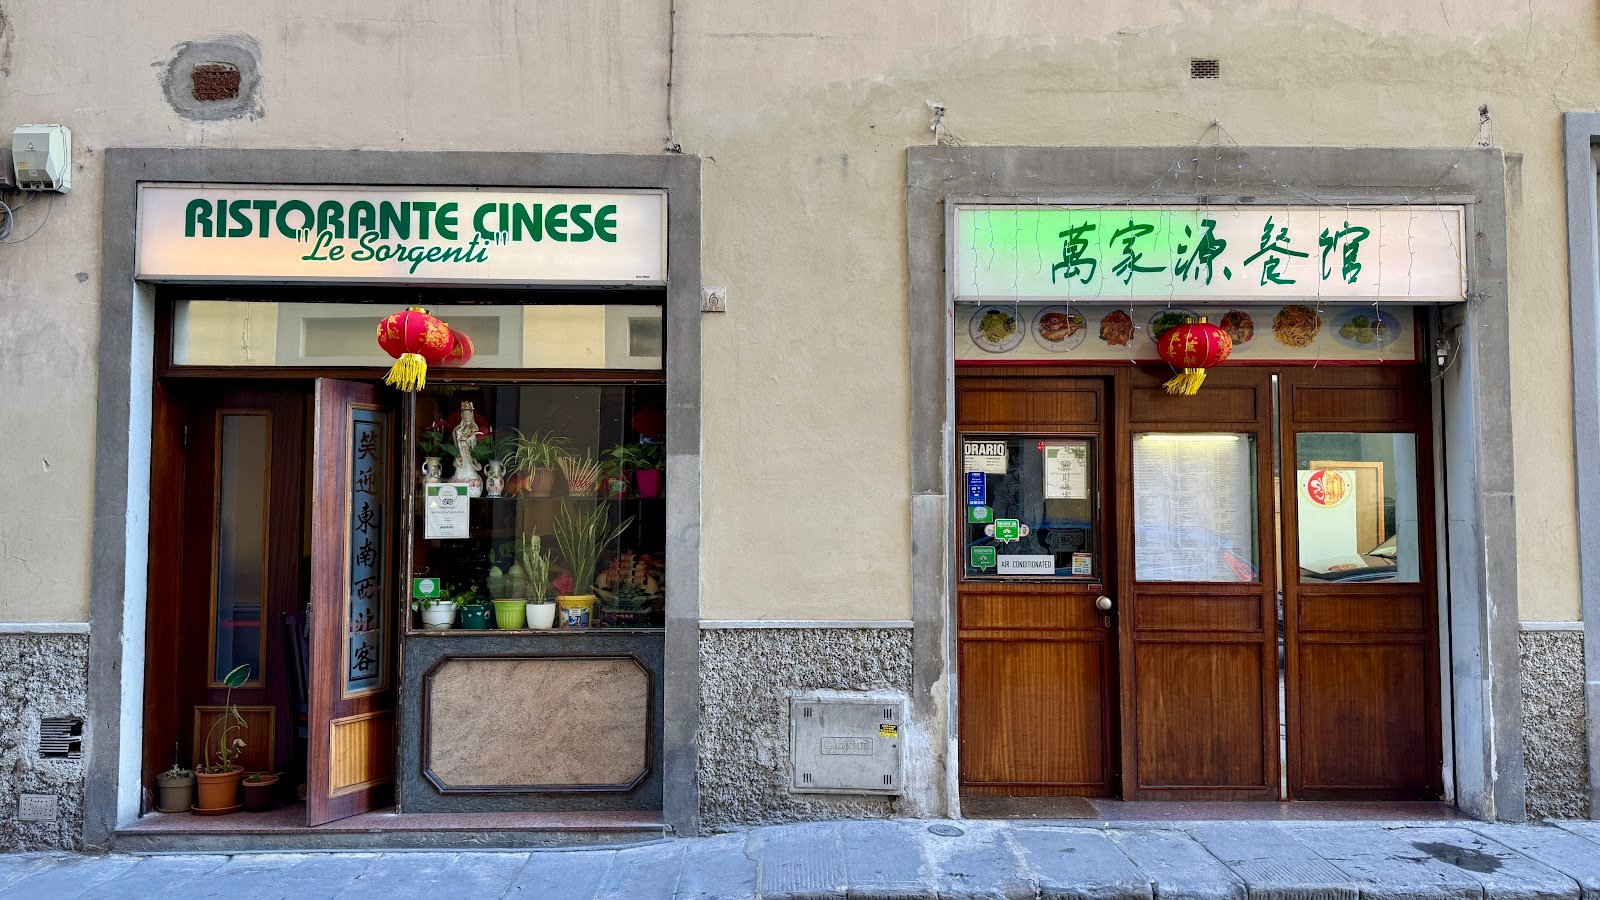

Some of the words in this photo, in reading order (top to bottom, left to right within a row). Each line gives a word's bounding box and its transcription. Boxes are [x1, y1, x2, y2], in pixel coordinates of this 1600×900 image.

[185, 199, 459, 241] RISTORANTE
[473, 203, 617, 243] CINESE
[708, 291, 719, 308] 6
[964, 443, 1005, 456] ORARIO
[1001, 560, 1010, 569] AIR
[1012, 560, 1052, 569] CONDITIONATED
